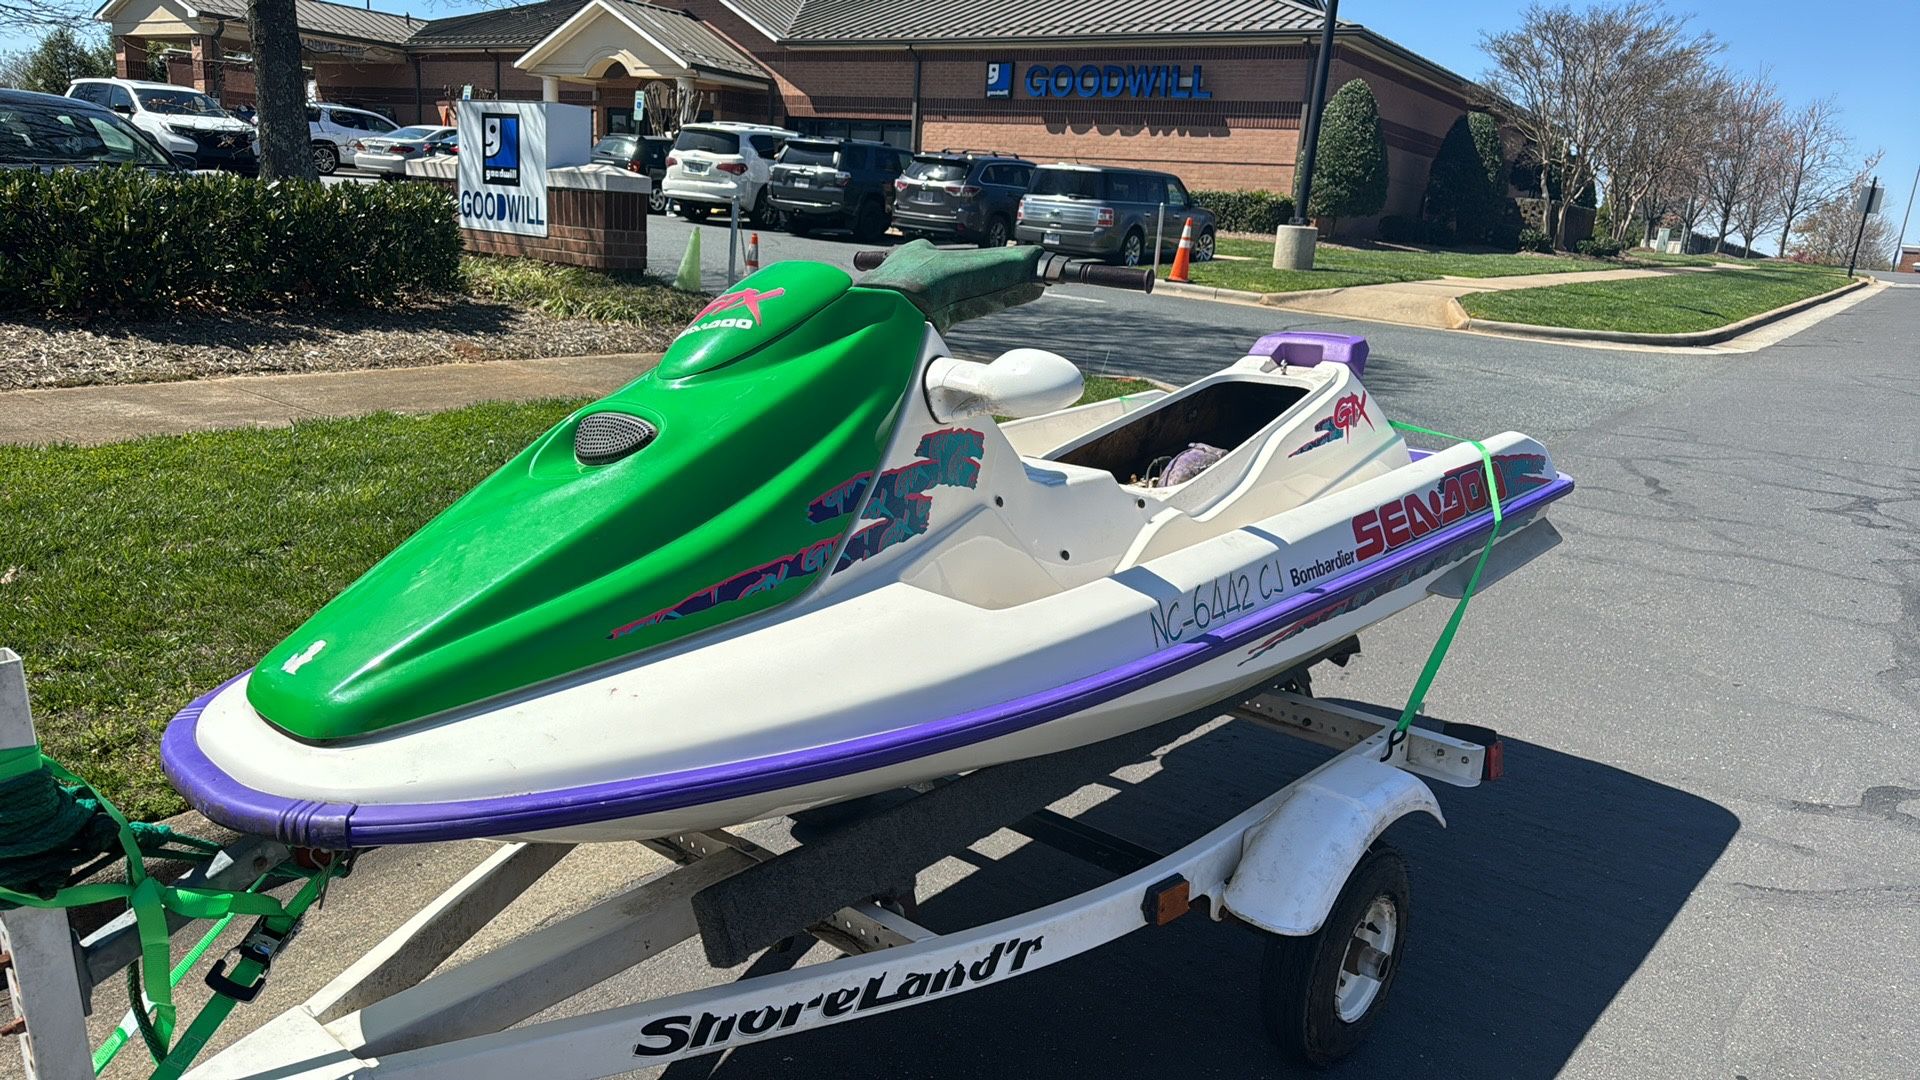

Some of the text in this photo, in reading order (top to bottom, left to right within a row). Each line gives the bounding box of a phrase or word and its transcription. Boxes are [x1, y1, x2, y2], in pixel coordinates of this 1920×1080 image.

[1024, 64, 1213, 98] GOODWILL
[485, 168, 517, 180] goodwill
[461, 190, 545, 226] GOODWILL
[1334, 389, 1376, 444] GTX
[1290, 549, 1356, 587] Bombardier
[1150, 570, 1255, 648] NC-6442
[633, 935, 1043, 1057] ShoreLand'r
